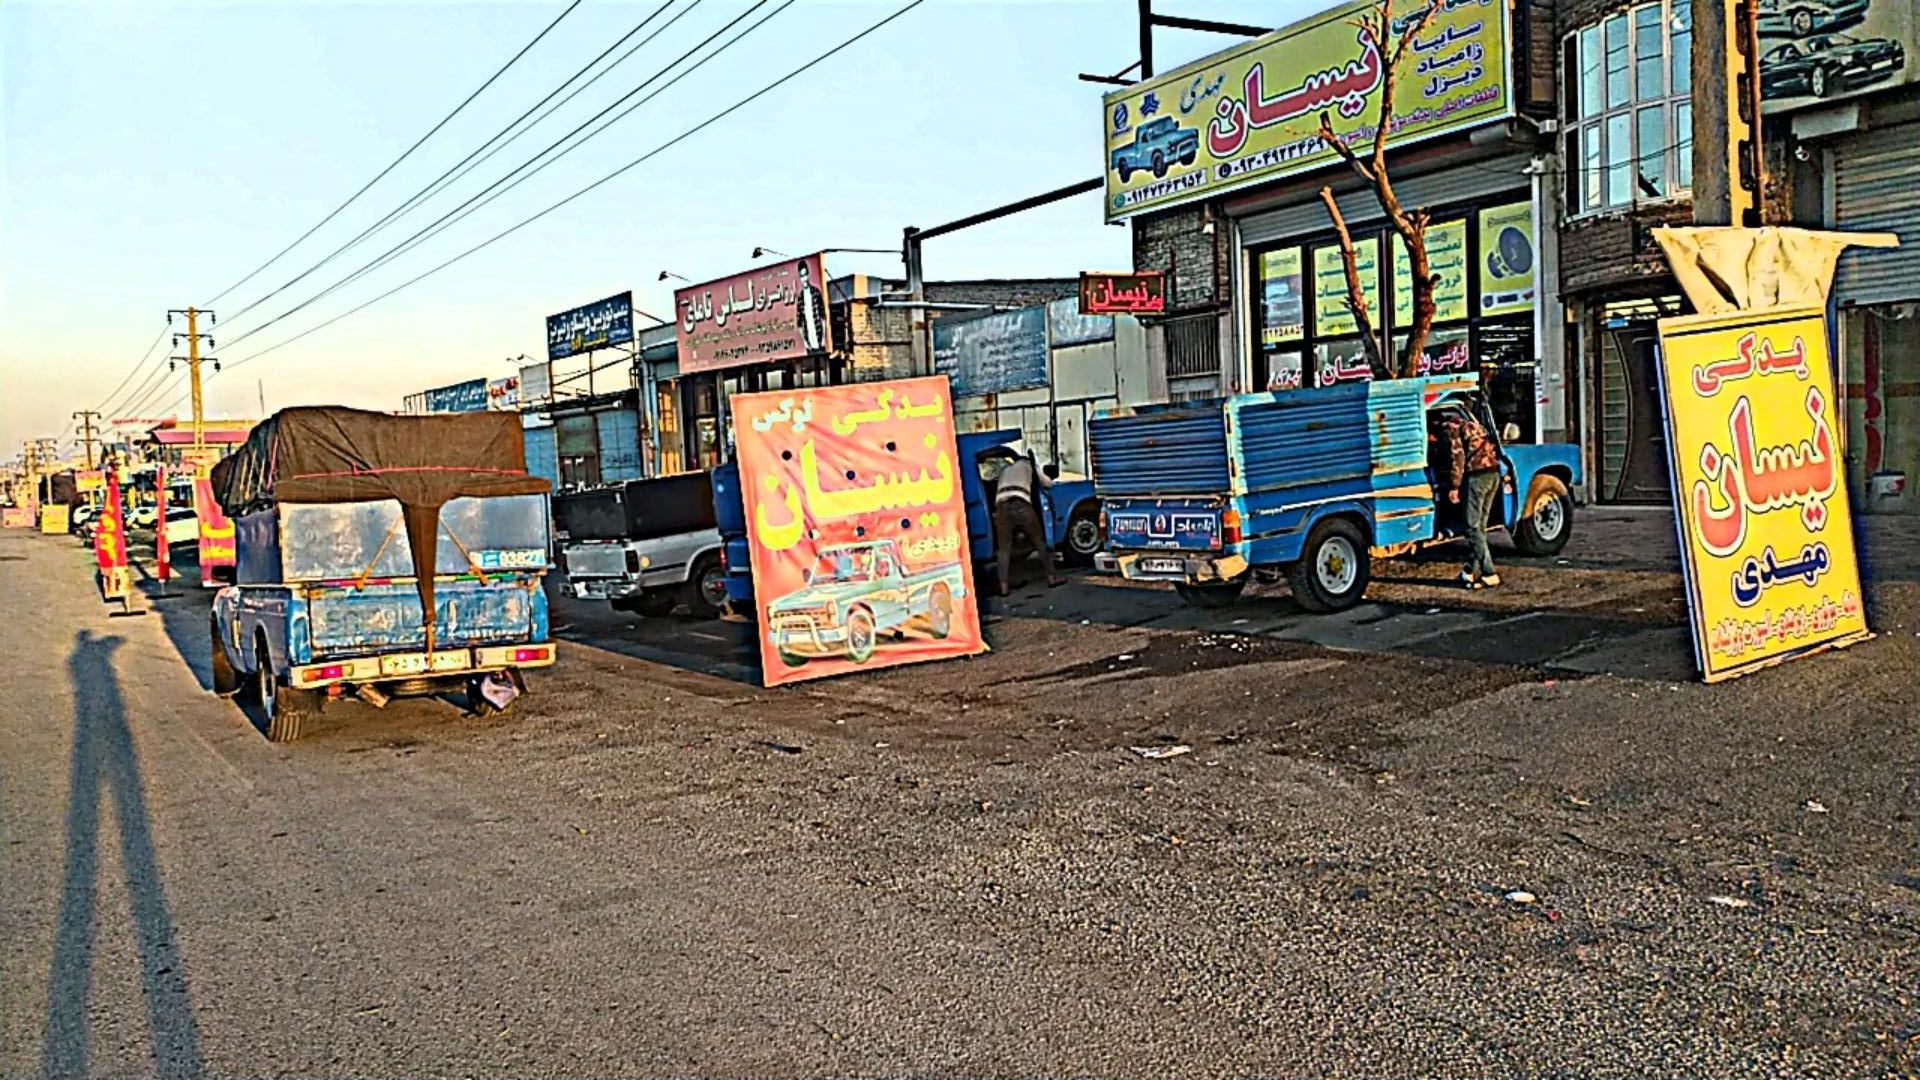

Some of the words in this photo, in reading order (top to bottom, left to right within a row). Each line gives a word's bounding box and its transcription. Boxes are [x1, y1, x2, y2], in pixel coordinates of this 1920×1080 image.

[1413, 21, 1483, 52] سایپا
[1417, 43, 1484, 75] زامیاد
[1208, 28, 1383, 157] نیسان
[1424, 67, 1483, 100] دیزل
[715, 279, 757, 327] لباس
[1322, 355, 1375, 386] یسان
[1433, 344, 1469, 371] لوکس
[1693, 333, 1809, 396] یدکی
[752, 396, 814, 433] لوکس
[833, 388, 945, 434] یدکی
[757, 433, 953, 550] نیسان
[1693, 387, 1837, 556] نیسان
[1733, 541, 1830, 607] مهدی
